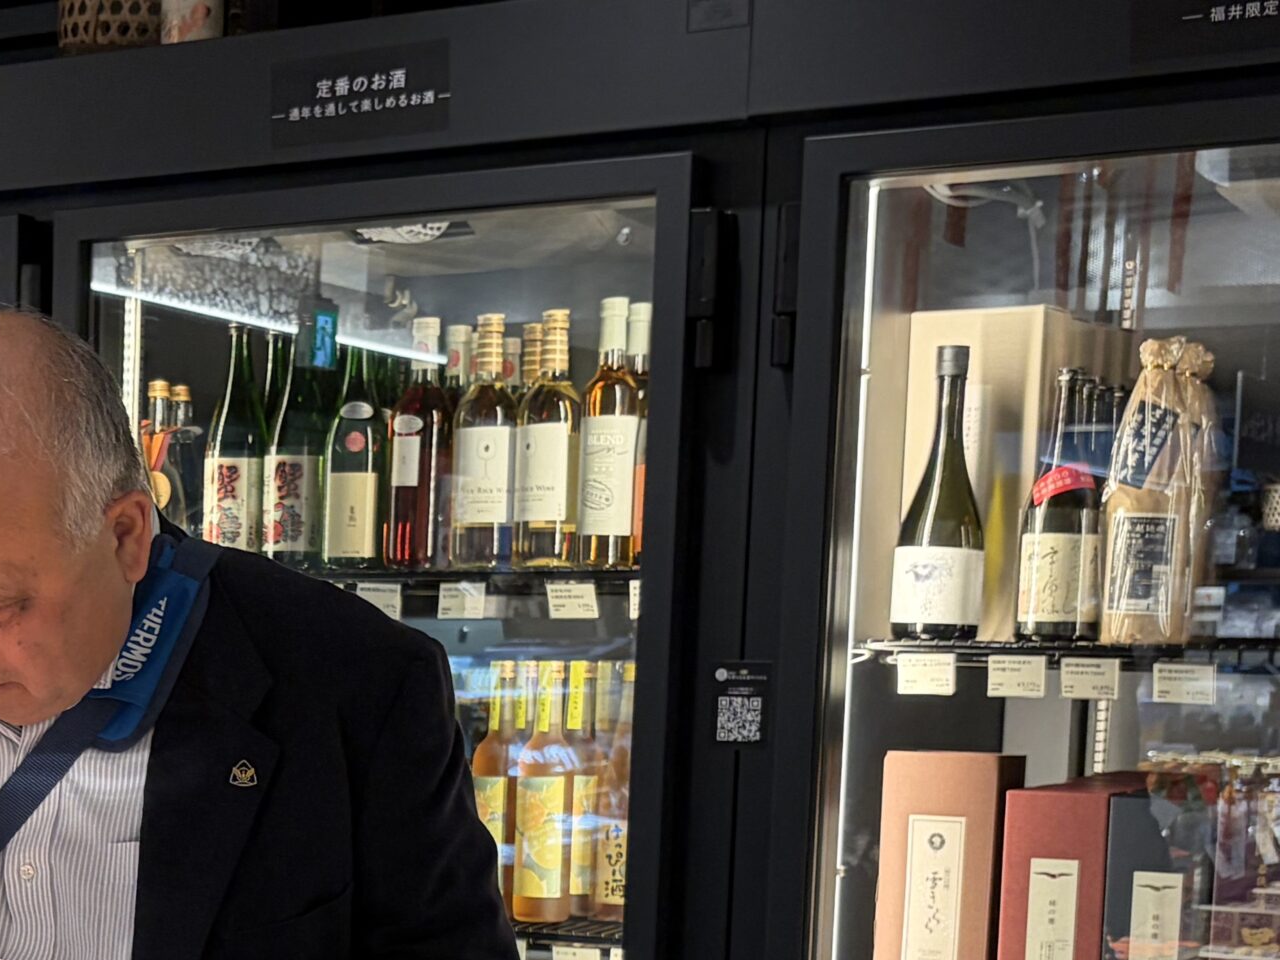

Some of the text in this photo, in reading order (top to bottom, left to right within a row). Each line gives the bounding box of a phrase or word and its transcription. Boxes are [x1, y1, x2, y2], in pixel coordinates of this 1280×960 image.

[1210, 1, 1279, 22] 福井限定
[316, 67, 406, 99] 定番のお酒
[288, 91, 435, 121] 通年を通して楽しめるお酒
[587, 434, 624, 446] BLEND
[112, 596, 167, 681] THERMOS
